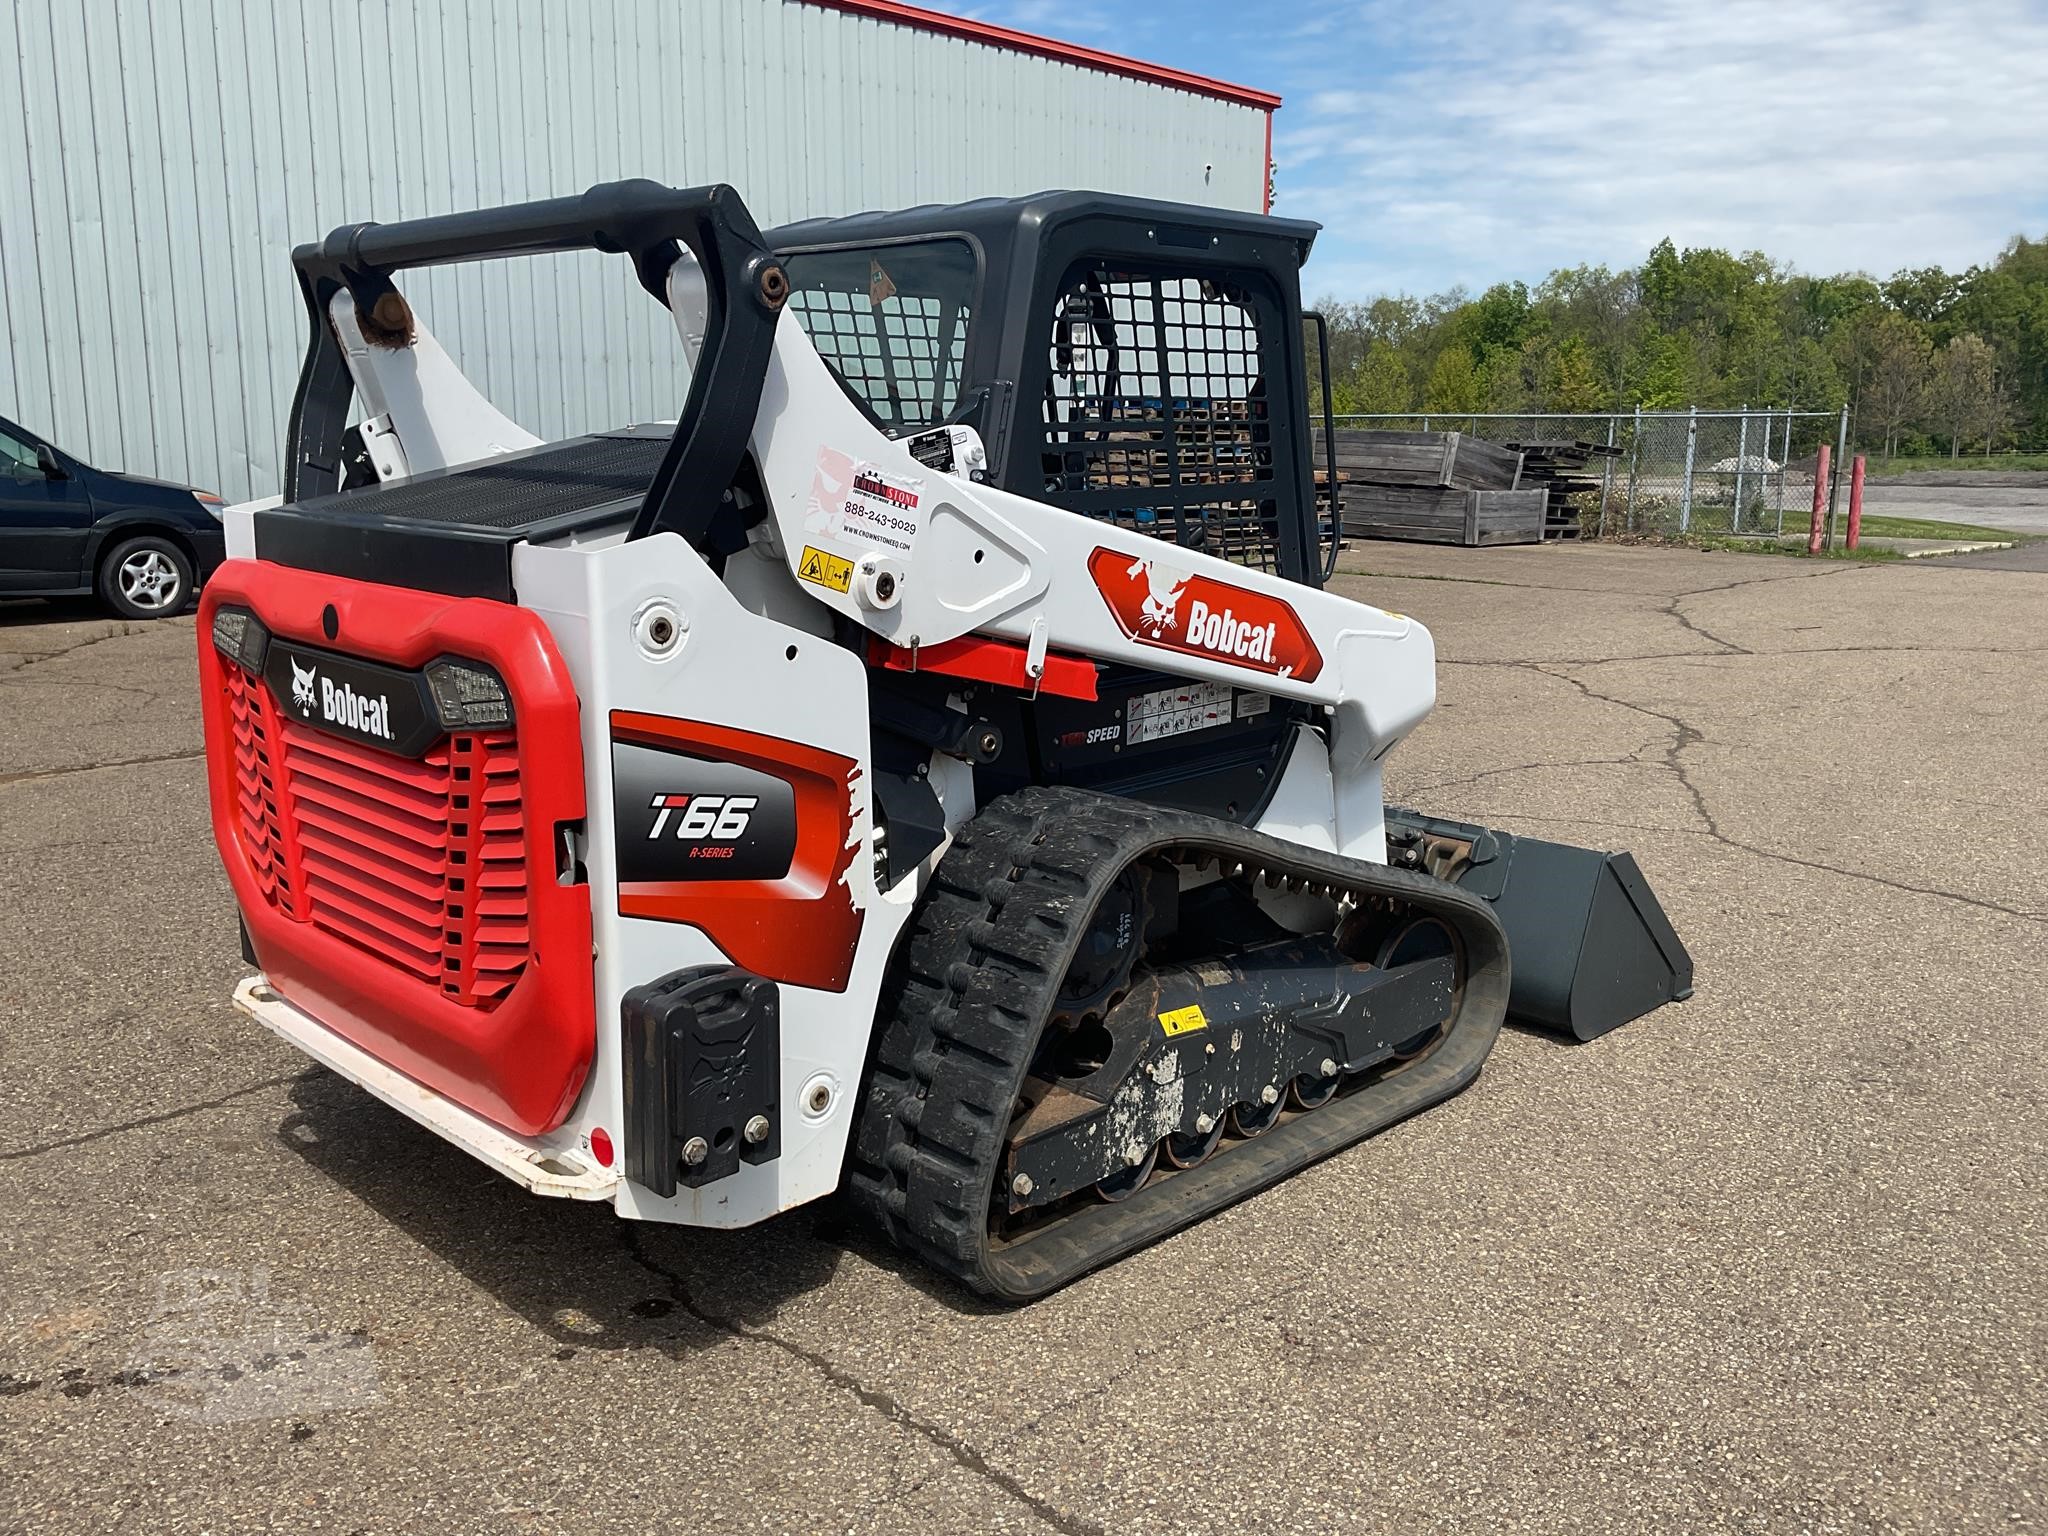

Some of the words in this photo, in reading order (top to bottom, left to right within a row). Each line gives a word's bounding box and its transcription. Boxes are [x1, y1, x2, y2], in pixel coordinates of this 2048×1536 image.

[844, 501, 917, 535] 888-243-9029
[843, 525, 911, 551] WWW.CROWNSTONEEQ.COM
[1186, 600, 1276, 663] Bobcat
[321, 677, 390, 740] Bobcat
[1086, 725, 1121, 744] SPEED
[648, 795, 758, 839] T66
[688, 847, 735, 858] R-SERIES
